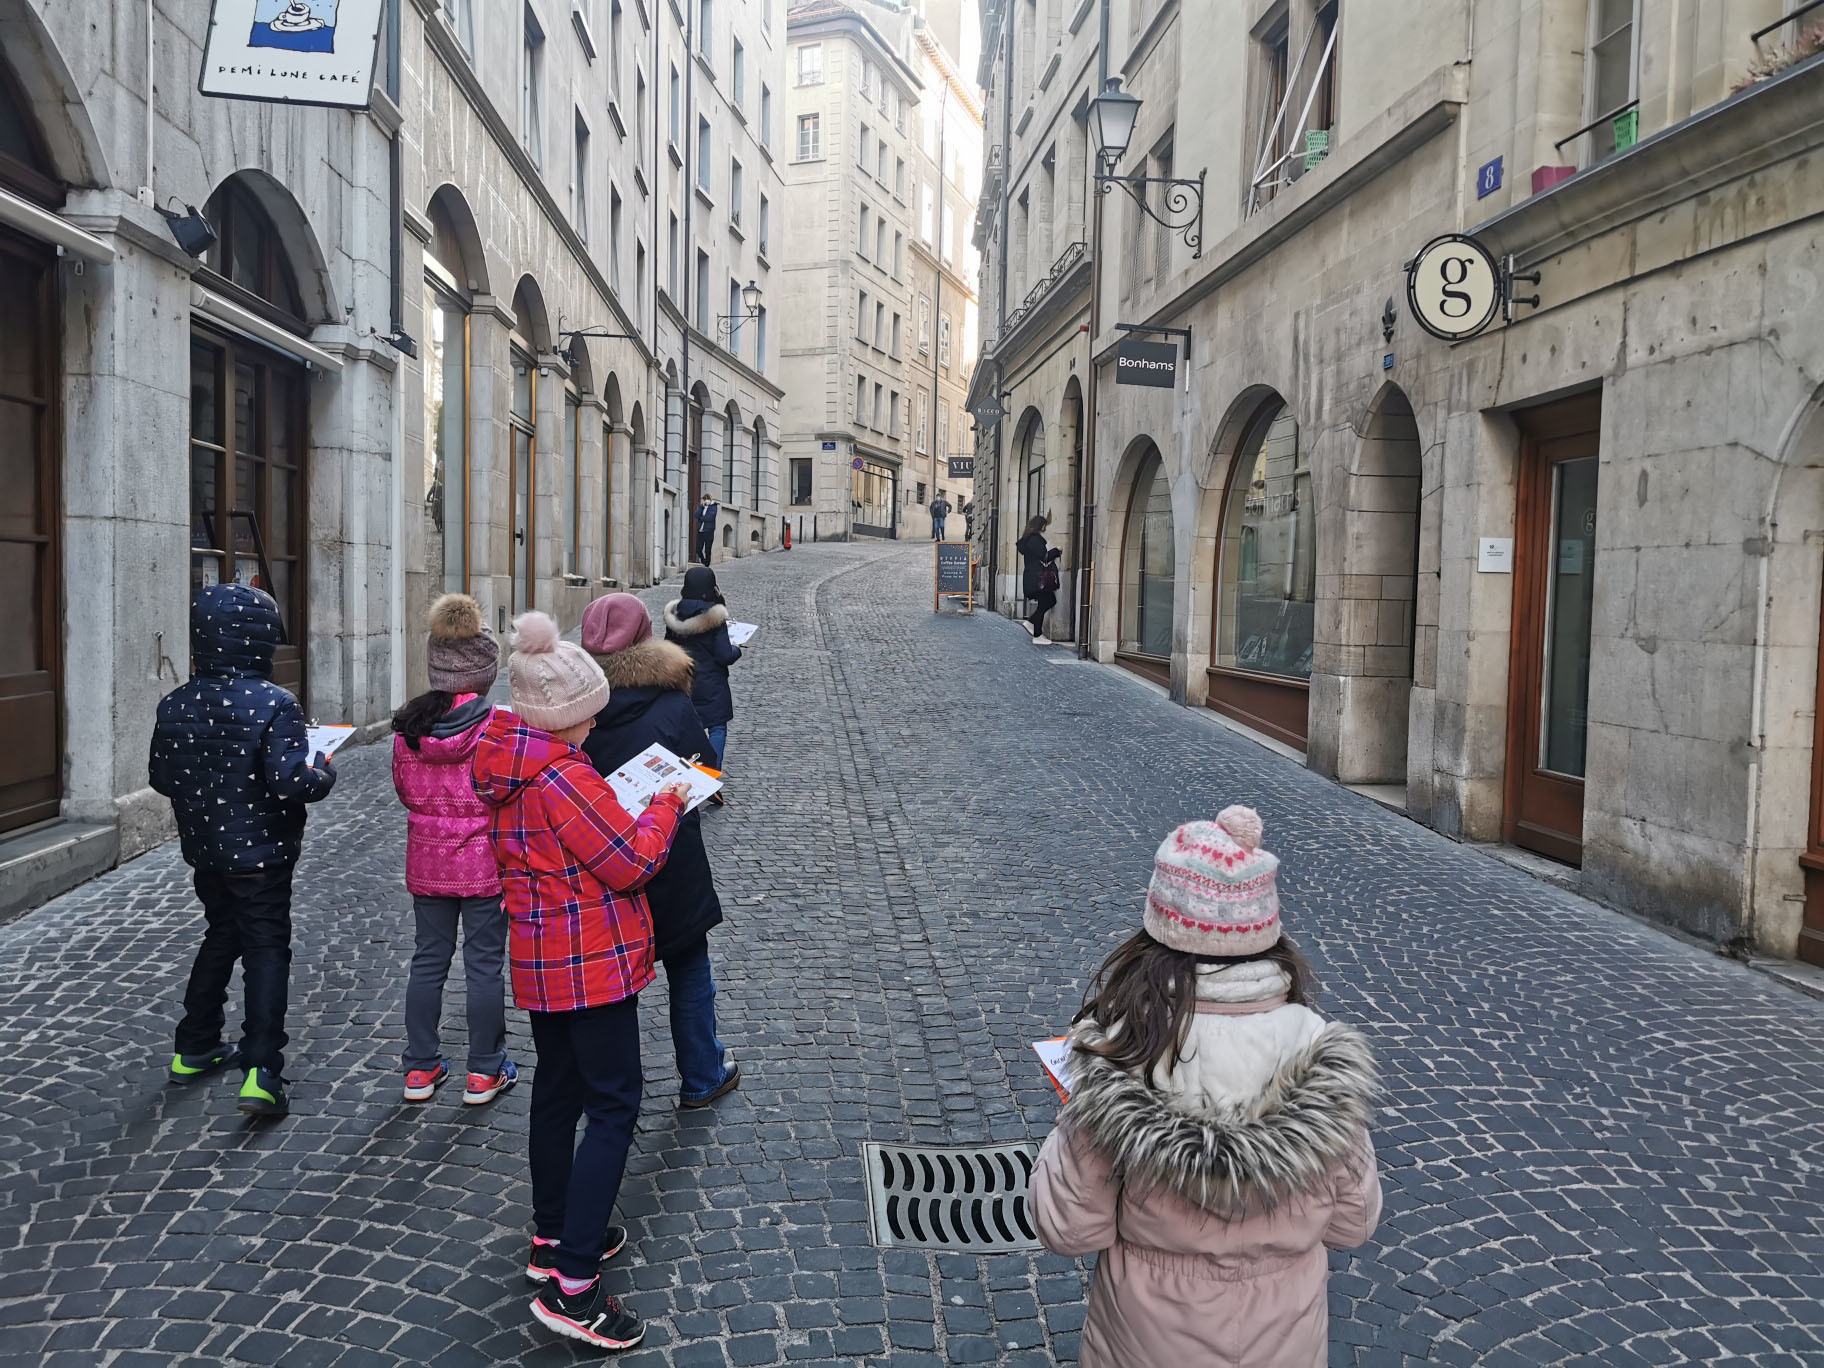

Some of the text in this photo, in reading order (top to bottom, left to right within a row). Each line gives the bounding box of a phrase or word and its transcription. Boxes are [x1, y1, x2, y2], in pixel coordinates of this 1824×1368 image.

[270, 68, 307, 79] LUNE
[319, 70, 360, 83] CAFÉ
[1485, 165, 1494, 189] 8
[1439, 257, 1475, 318] g
[1119, 357, 1174, 371] Bonhams
[952, 461, 972, 470] VIU
